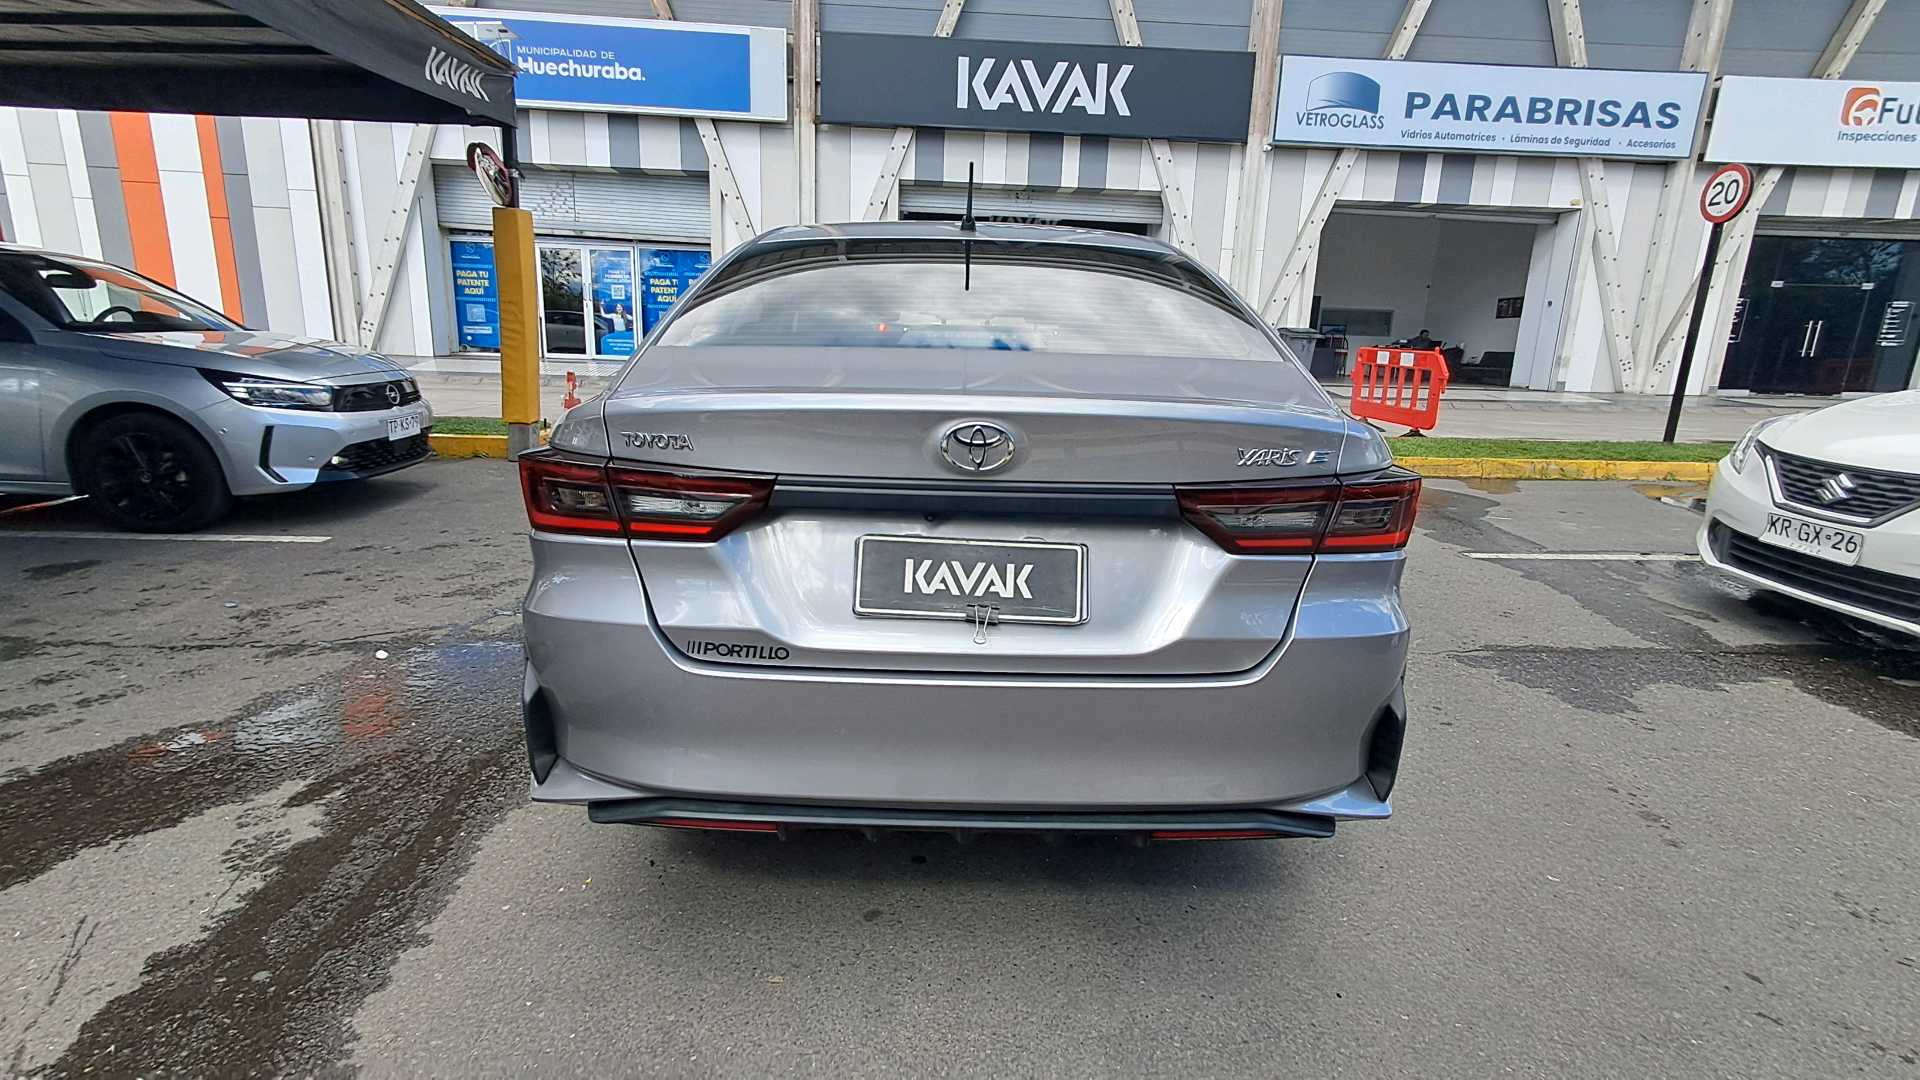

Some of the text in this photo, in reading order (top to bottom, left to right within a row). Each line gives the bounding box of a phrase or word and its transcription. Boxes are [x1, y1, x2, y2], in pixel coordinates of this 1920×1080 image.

[517, 46, 615, 60] MUNICIPALIDAD DE
[425, 46, 490, 102] KAVAK
[517, 57, 646, 82] Huechuraba.
[957, 56, 1134, 116] KAVAK
[1296, 111, 1385, 130] VETROGLASS
[1404, 91, 1682, 130] PARABRISAS
[1400, 129, 1432, 140] Vidrios
[1434, 131, 1497, 142] Automotrices
[1550, 136, 1562, 145] de
[1563, 136, 1611, 148] Seguridad
[1626, 138, 1677, 149] Accesorios
[1837, 131, 1918, 143] Inspecciones
[1708, 179, 1740, 207] 20
[621, 431, 694, 451] TOYOTA
[904, 558, 1034, 599] KAVAK
[703, 641, 790, 660] PORTILLO
